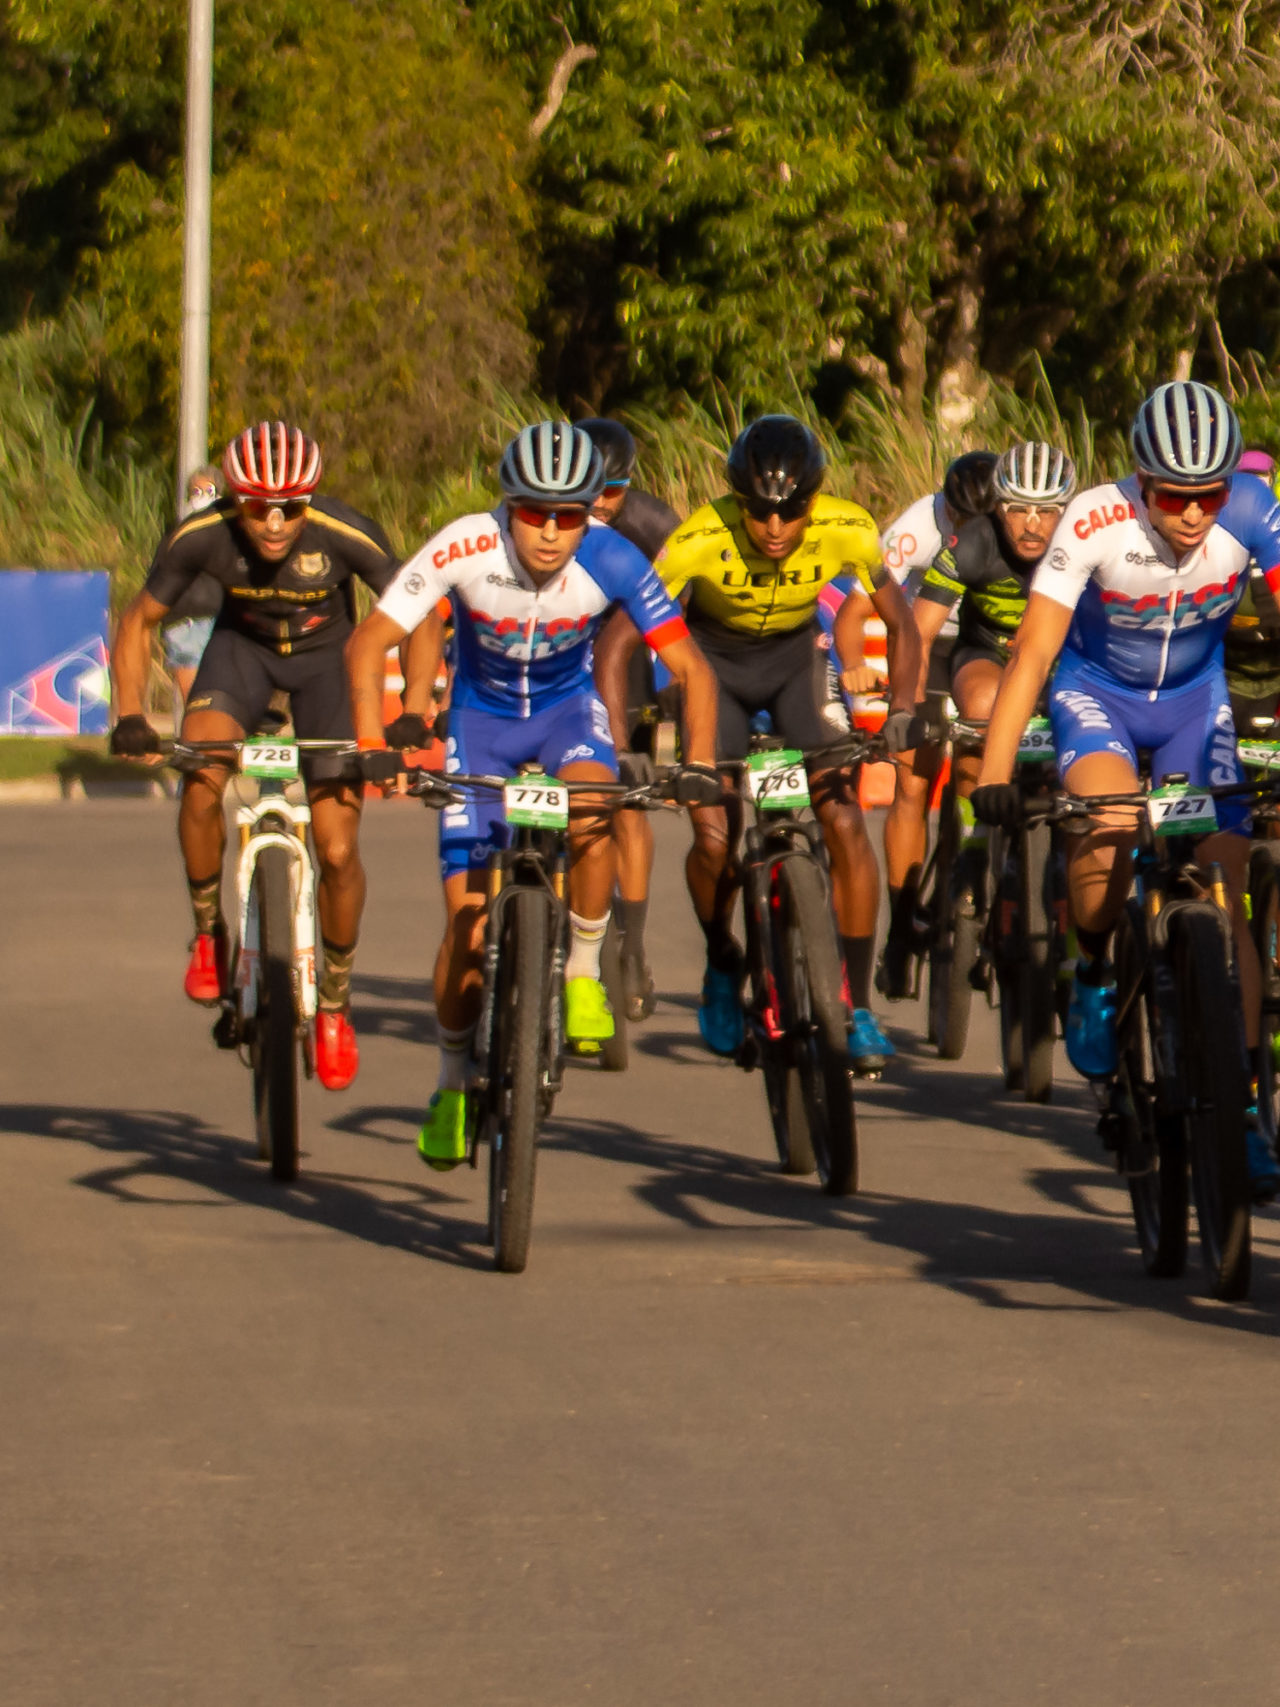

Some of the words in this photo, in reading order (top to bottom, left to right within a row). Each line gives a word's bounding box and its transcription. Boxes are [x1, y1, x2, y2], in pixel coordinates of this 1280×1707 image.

[1073, 501, 1136, 540] CALOI
[432, 532, 500, 569] CALOI
[251, 748, 292, 762] 728
[514, 788, 560, 806] 778
[1158, 800, 1208, 818] 727
